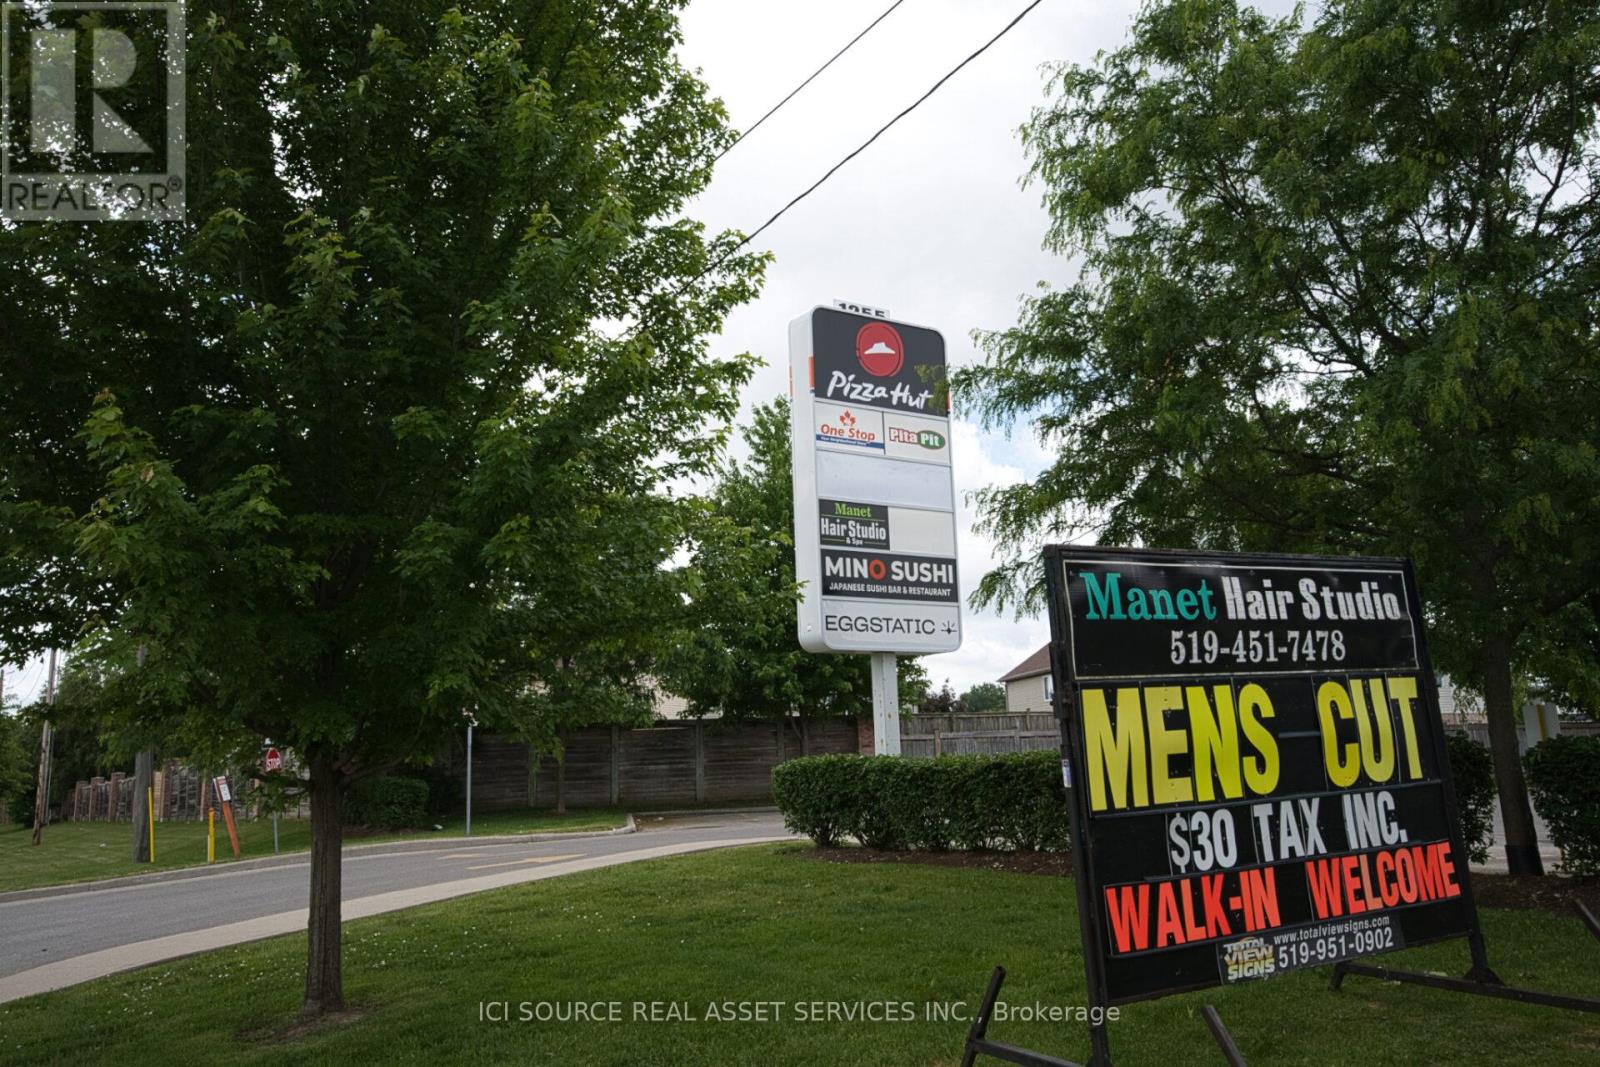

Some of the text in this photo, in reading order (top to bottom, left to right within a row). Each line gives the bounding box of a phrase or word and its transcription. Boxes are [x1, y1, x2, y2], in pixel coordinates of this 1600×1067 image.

[827, 370, 934, 410] Pizza Hut
[821, 424, 845, 436] One
[848, 428, 875, 442] Stop
[889, 427, 941, 447] Pita Pit
[834, 502, 872, 517] Manet
[820, 517, 887, 540] Hair Studio
[825, 556, 953, 584] MINO SUSHI
[829, 582, 951, 597] JAPANESE SUSHI BAR & RESTAURANT
[1080, 572, 1401, 621] Manet Hair Studio
[825, 615, 936, 635] EGGSTATIC
[1170, 629, 1346, 665] 519-451-7478
[1081, 676, 1423, 812] MENS CUT
[1168, 790, 1408, 874] $30 TAX INC.
[1105, 841, 1461, 954] WALK-IN WELCOME
[1273, 915, 1390, 945] www.totalviewsigns.com
[1223, 937, 1268, 953] TOTAL
[1224, 945, 1274, 967] VIEW
[1278, 926, 1394, 969] 519-951-0902
[1227, 959, 1276, 981] SIGNS
